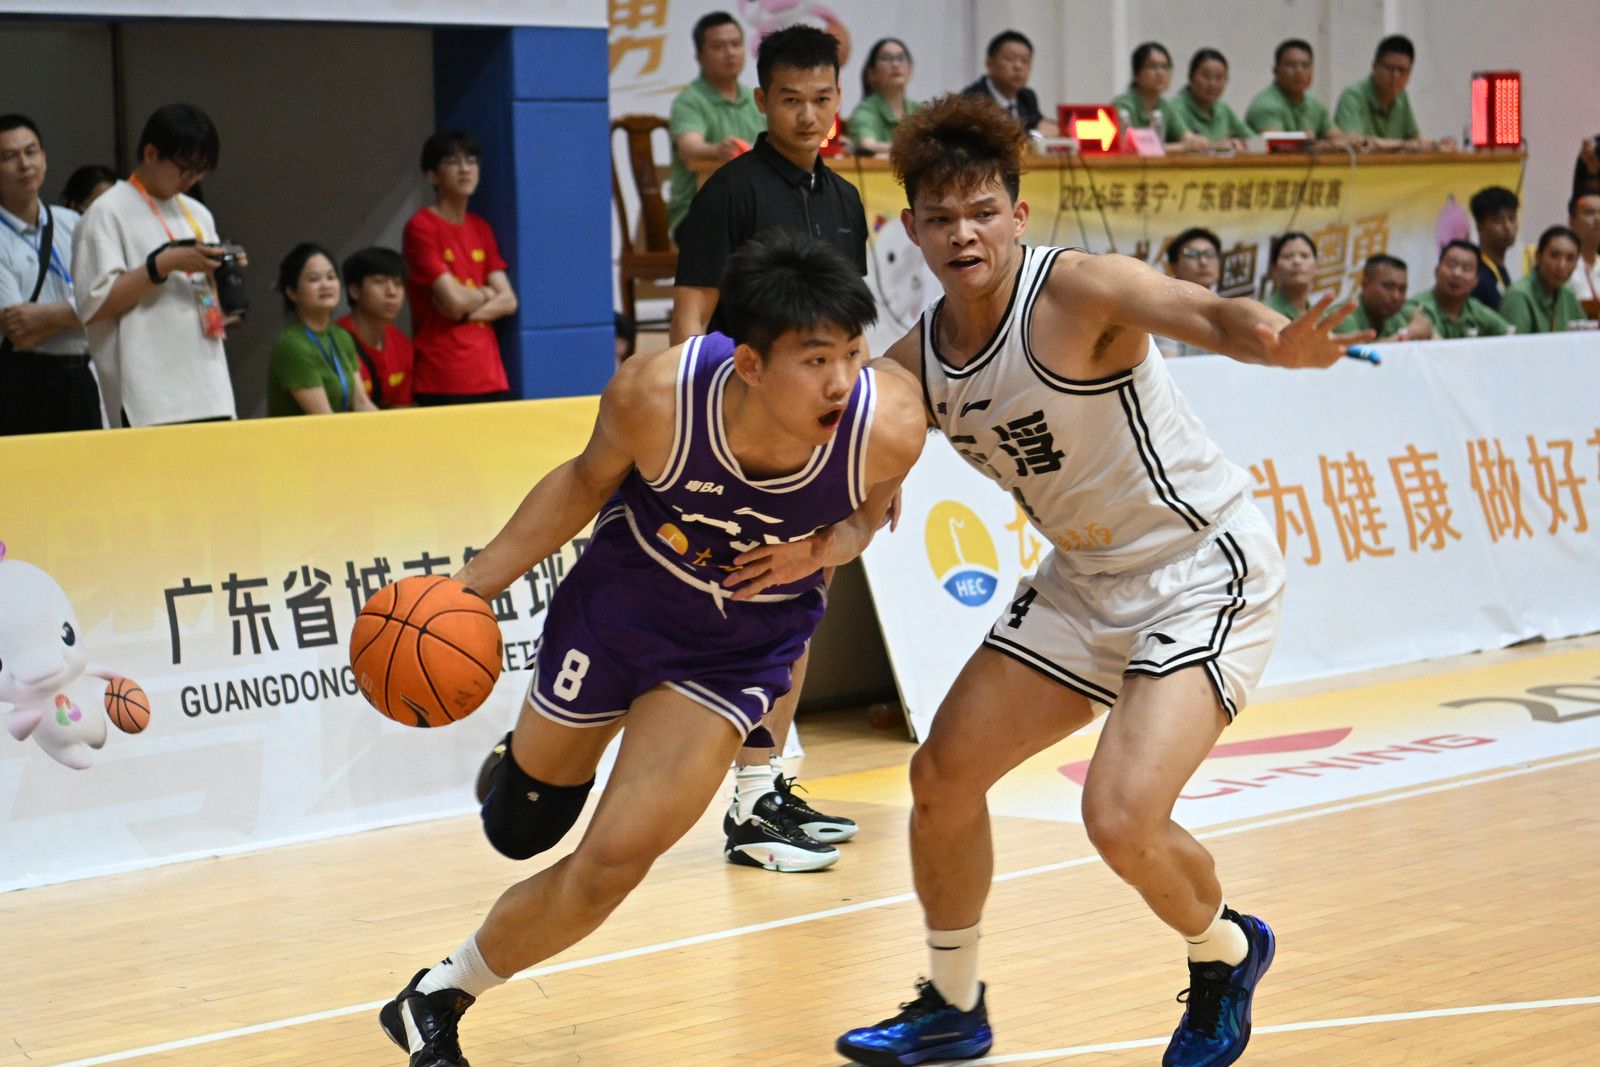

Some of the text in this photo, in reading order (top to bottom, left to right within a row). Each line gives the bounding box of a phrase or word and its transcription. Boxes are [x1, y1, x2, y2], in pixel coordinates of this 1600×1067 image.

[1249, 428, 1600, 566] 为健康 做好
[955, 577, 988, 598] HEC
[180, 665, 359, 718] GUANGDONG
[553, 648, 591, 702] 8
